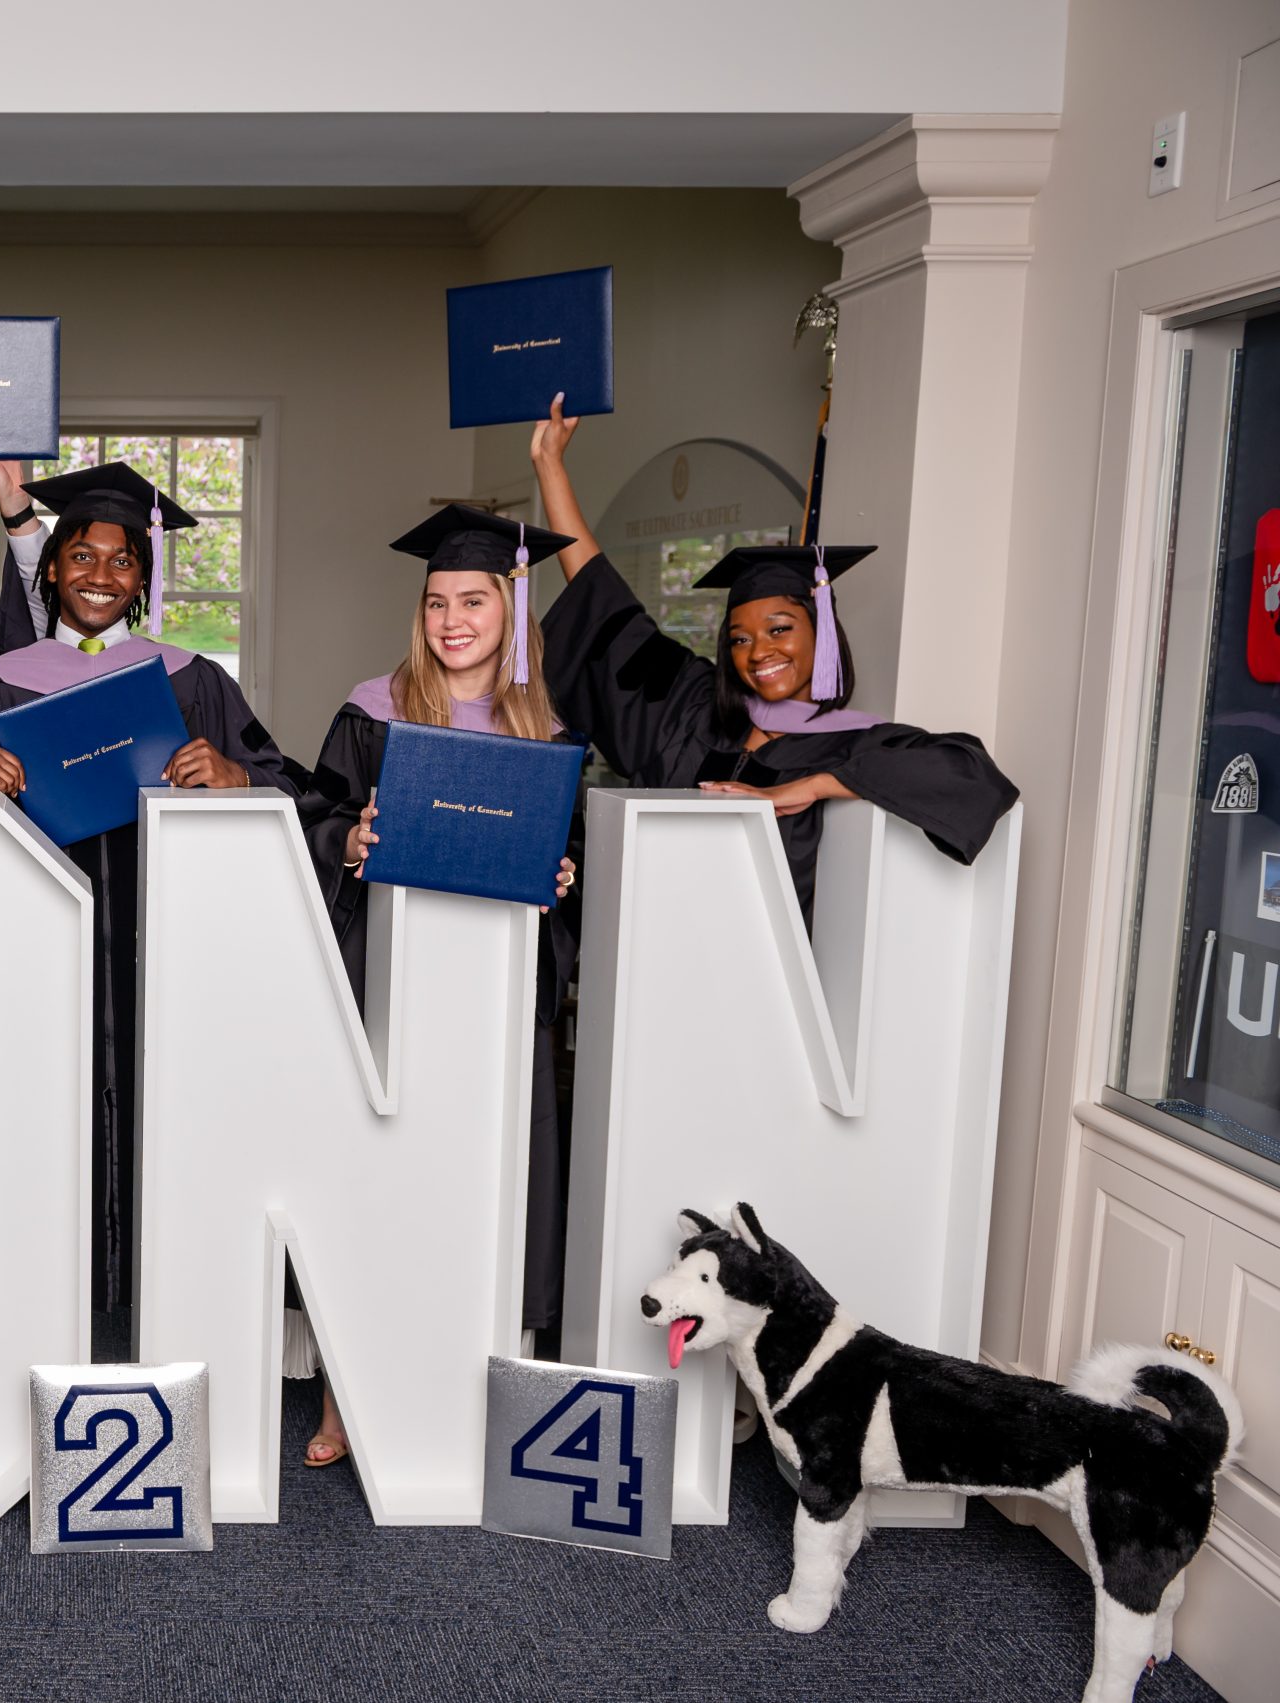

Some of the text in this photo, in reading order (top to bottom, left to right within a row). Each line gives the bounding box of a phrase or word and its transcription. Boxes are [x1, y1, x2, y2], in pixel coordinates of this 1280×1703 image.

[492, 343, 521, 353] University
[529, 337, 561, 348] Connecticut
[62, 753, 92, 769] University
[100, 736, 133, 753] Connecticut
[432, 799, 466, 812] University
[477, 805, 513, 817] Connecticut
[1227, 951, 1280, 1037] U
